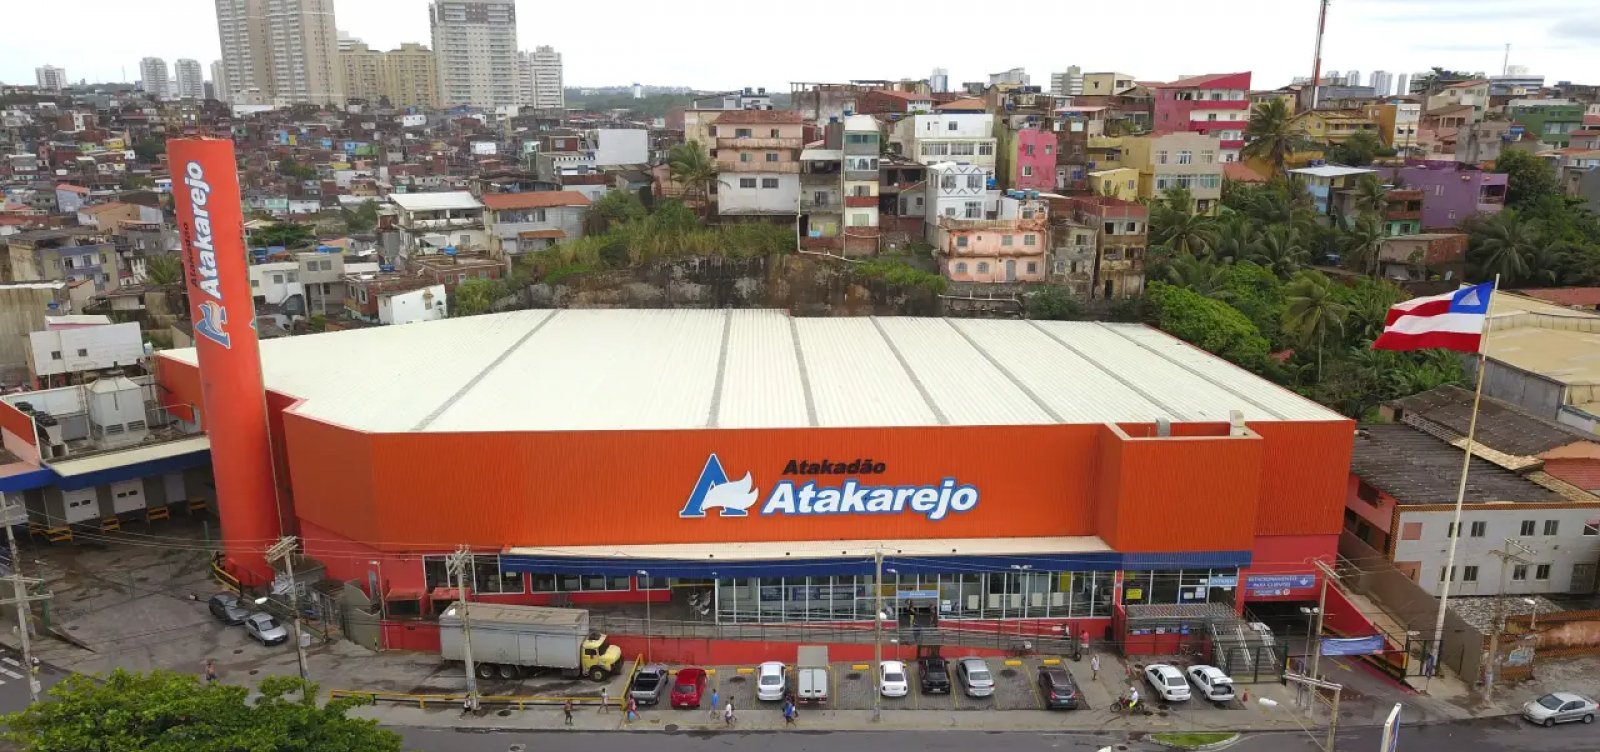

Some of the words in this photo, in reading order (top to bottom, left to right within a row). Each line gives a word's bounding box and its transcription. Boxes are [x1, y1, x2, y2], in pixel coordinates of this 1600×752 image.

[185, 161, 222, 300] Atakarejo
[783, 459, 886, 475] Atakadão
[761, 478, 979, 520] Atakarejo
